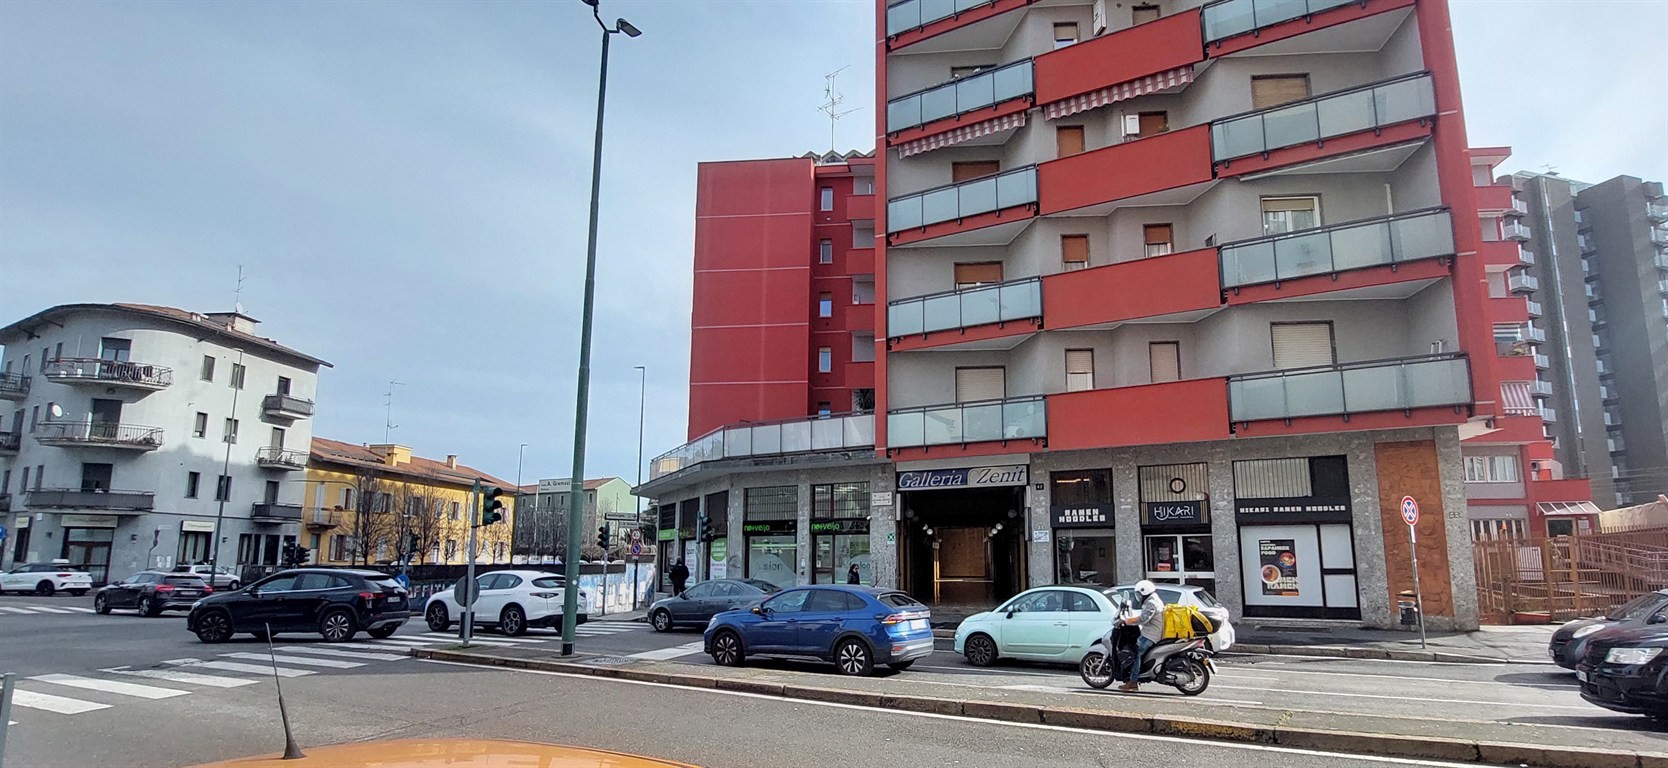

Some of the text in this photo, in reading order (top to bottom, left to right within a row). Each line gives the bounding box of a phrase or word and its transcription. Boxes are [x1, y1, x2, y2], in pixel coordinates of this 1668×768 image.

[899, 467, 1025, 488] Galleria Zenit
[1064, 508, 1099, 516] RAMEN
[1154, 505, 1194, 520] HIKARI
[1059, 514, 1106, 523] NOODLES
